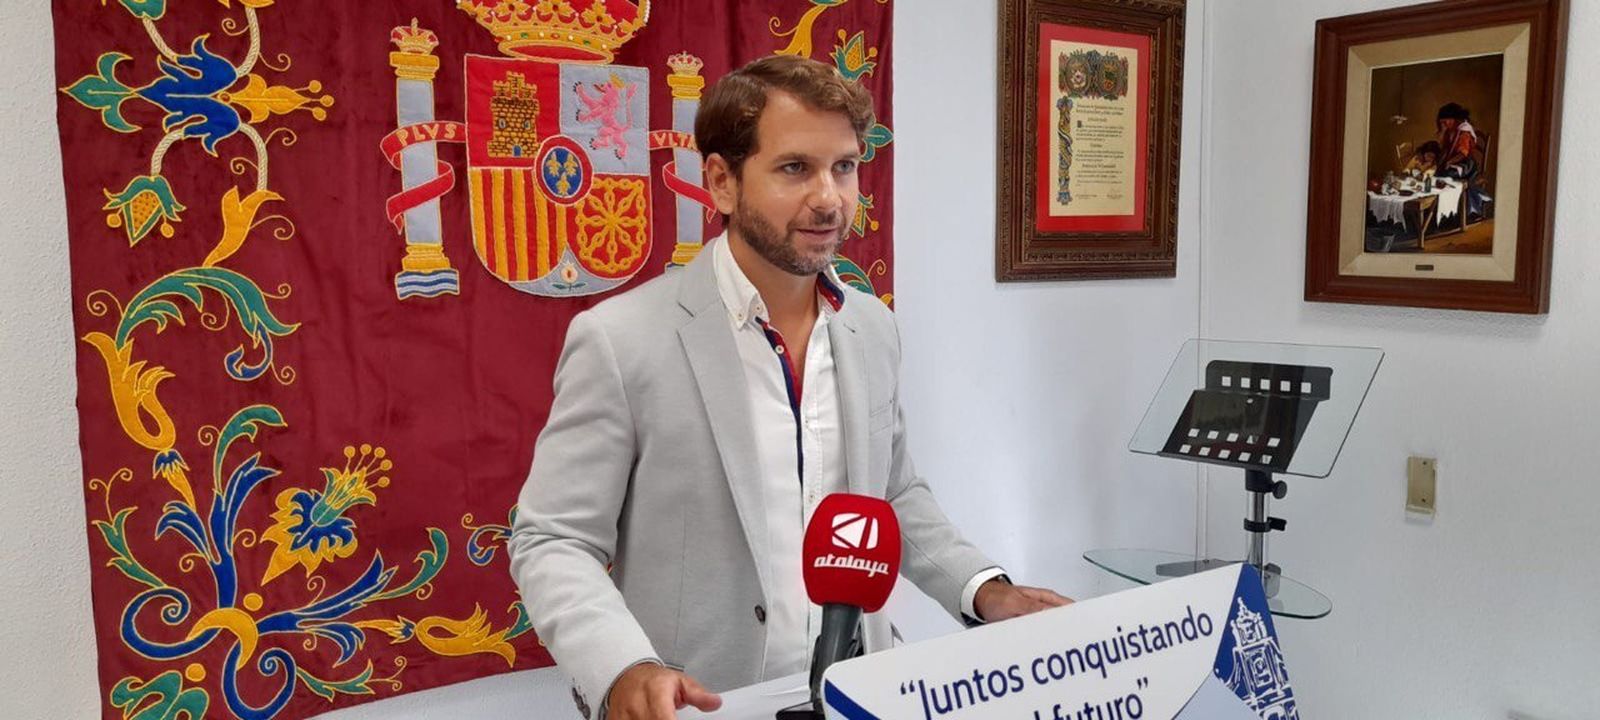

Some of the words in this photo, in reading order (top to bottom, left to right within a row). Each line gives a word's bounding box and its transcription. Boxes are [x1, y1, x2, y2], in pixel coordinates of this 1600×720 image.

[396, 123, 456, 147] PLVS
[814, 553, 889, 577] atalaya
[1031, 605, 1213, 685] conquistando
